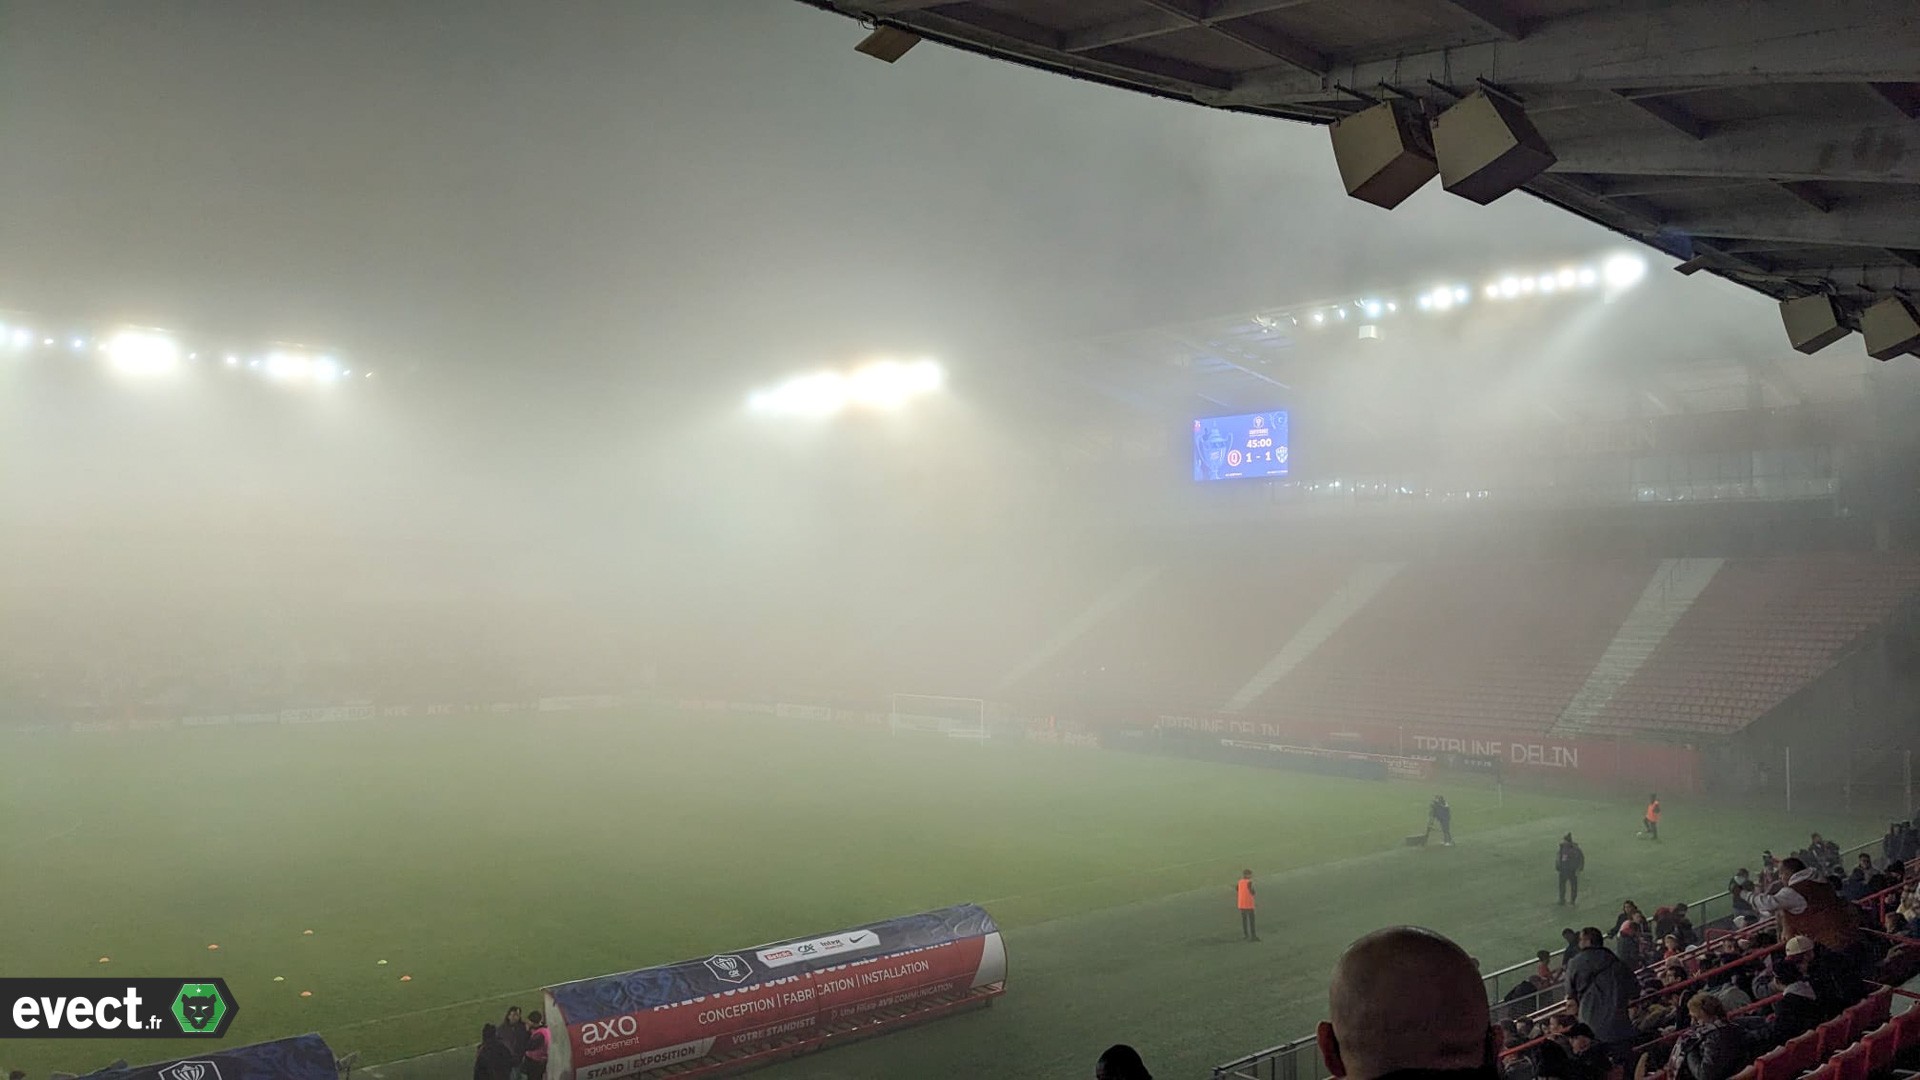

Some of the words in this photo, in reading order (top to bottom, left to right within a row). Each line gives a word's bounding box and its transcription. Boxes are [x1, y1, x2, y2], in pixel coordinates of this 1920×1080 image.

[1246, 438, 1272, 448] 45:00
[1246, 452, 1252, 463] 1
[1265, 451, 1271, 461] 1
[1511, 743, 1578, 768] DELIN
[698, 996, 775, 1025] CONCEPTION
[783, 977, 854, 1006] FABRICATION
[862, 960, 930, 985] INSTALLATION
[896, 982, 954, 1003] COMMUNICATION
[581, 1016, 637, 1045] axo
[732, 1026, 764, 1044] VOTRE
[766, 1016, 816, 1039] STANDISTE
[584, 1035, 640, 1056] agencement
[587, 1062, 625, 1080] STAND
[633, 1046, 696, 1069] EXPOSITION
